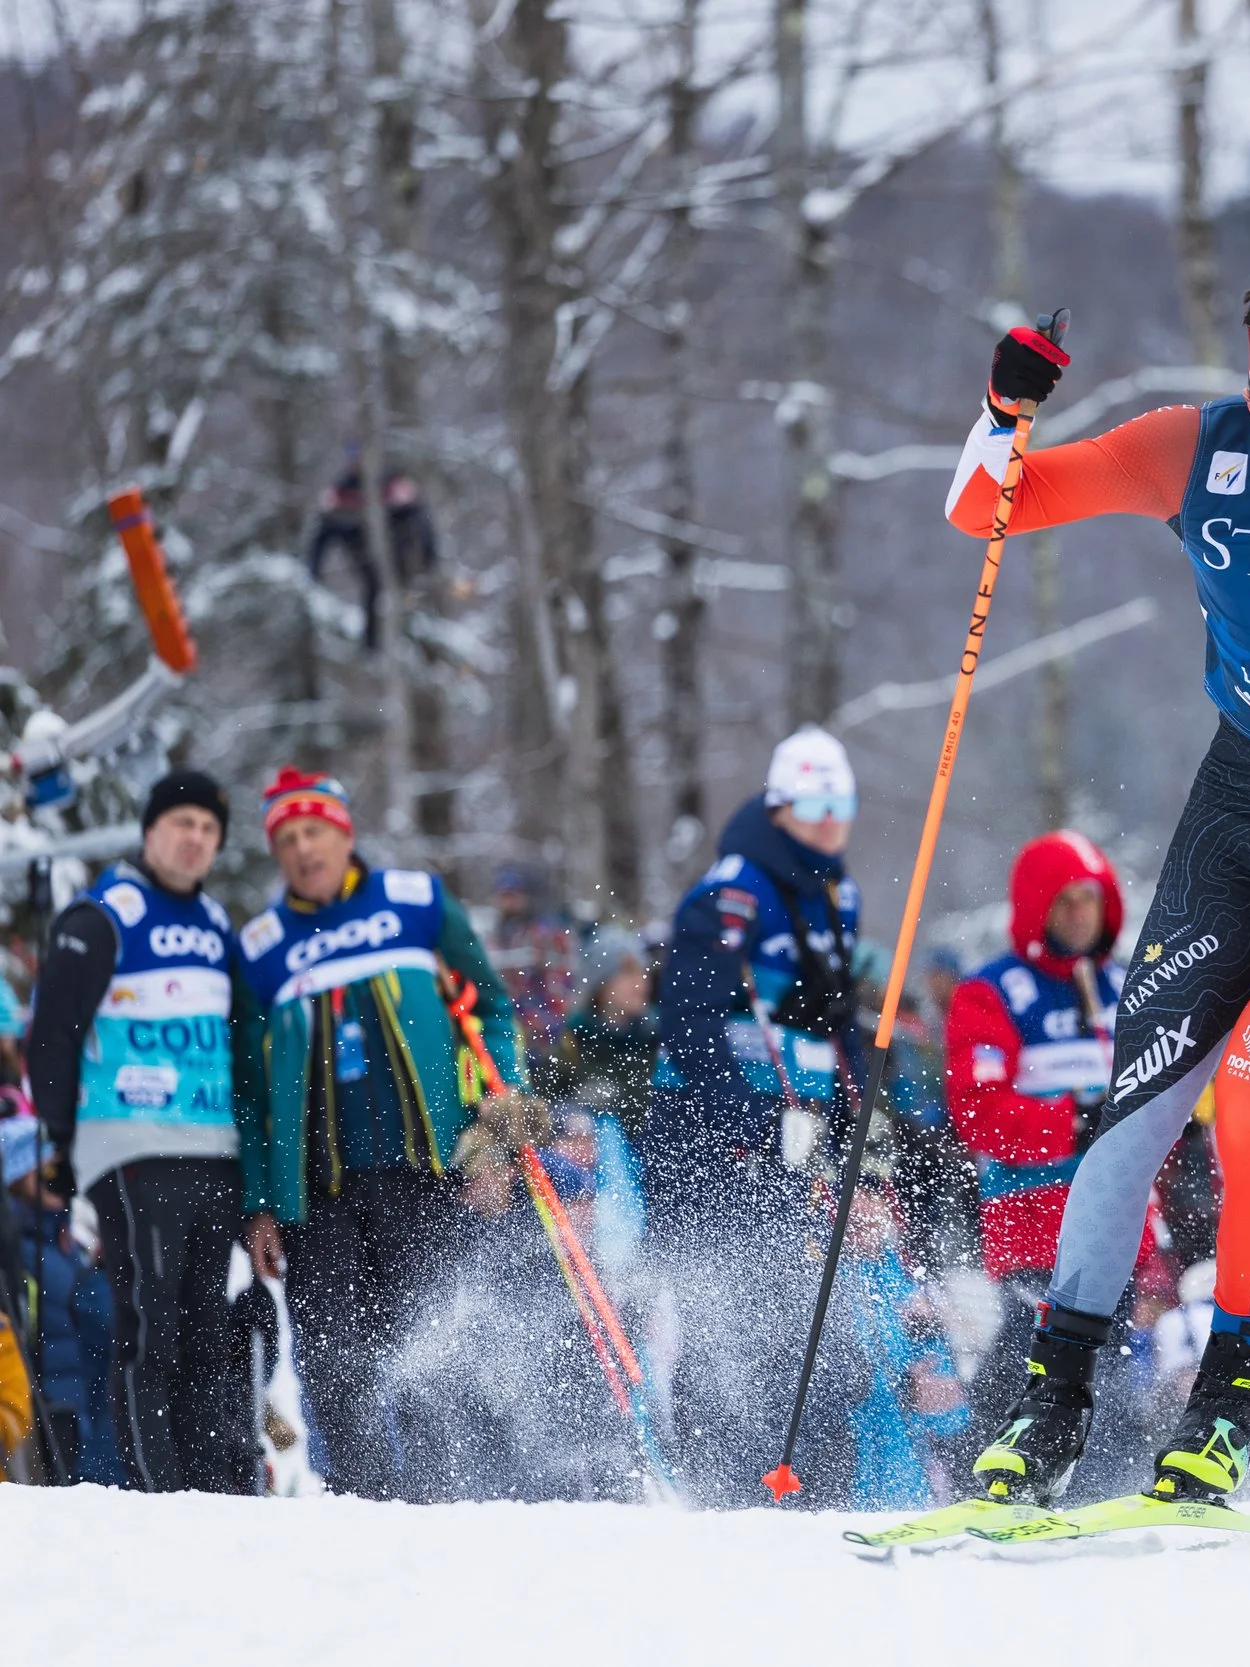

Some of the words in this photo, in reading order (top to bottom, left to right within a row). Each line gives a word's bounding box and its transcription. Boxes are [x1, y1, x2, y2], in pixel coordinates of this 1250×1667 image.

[939, 731, 957, 777] PREMIO
[951, 711, 962, 725] 40
[149, 924, 225, 964] coop
[285, 910, 402, 974] coop
[1164, 924, 1192, 944] MARKETS
[1123, 934, 1219, 1015] HAYWOOD
[1175, 1505, 1207, 1519] FISCHER
